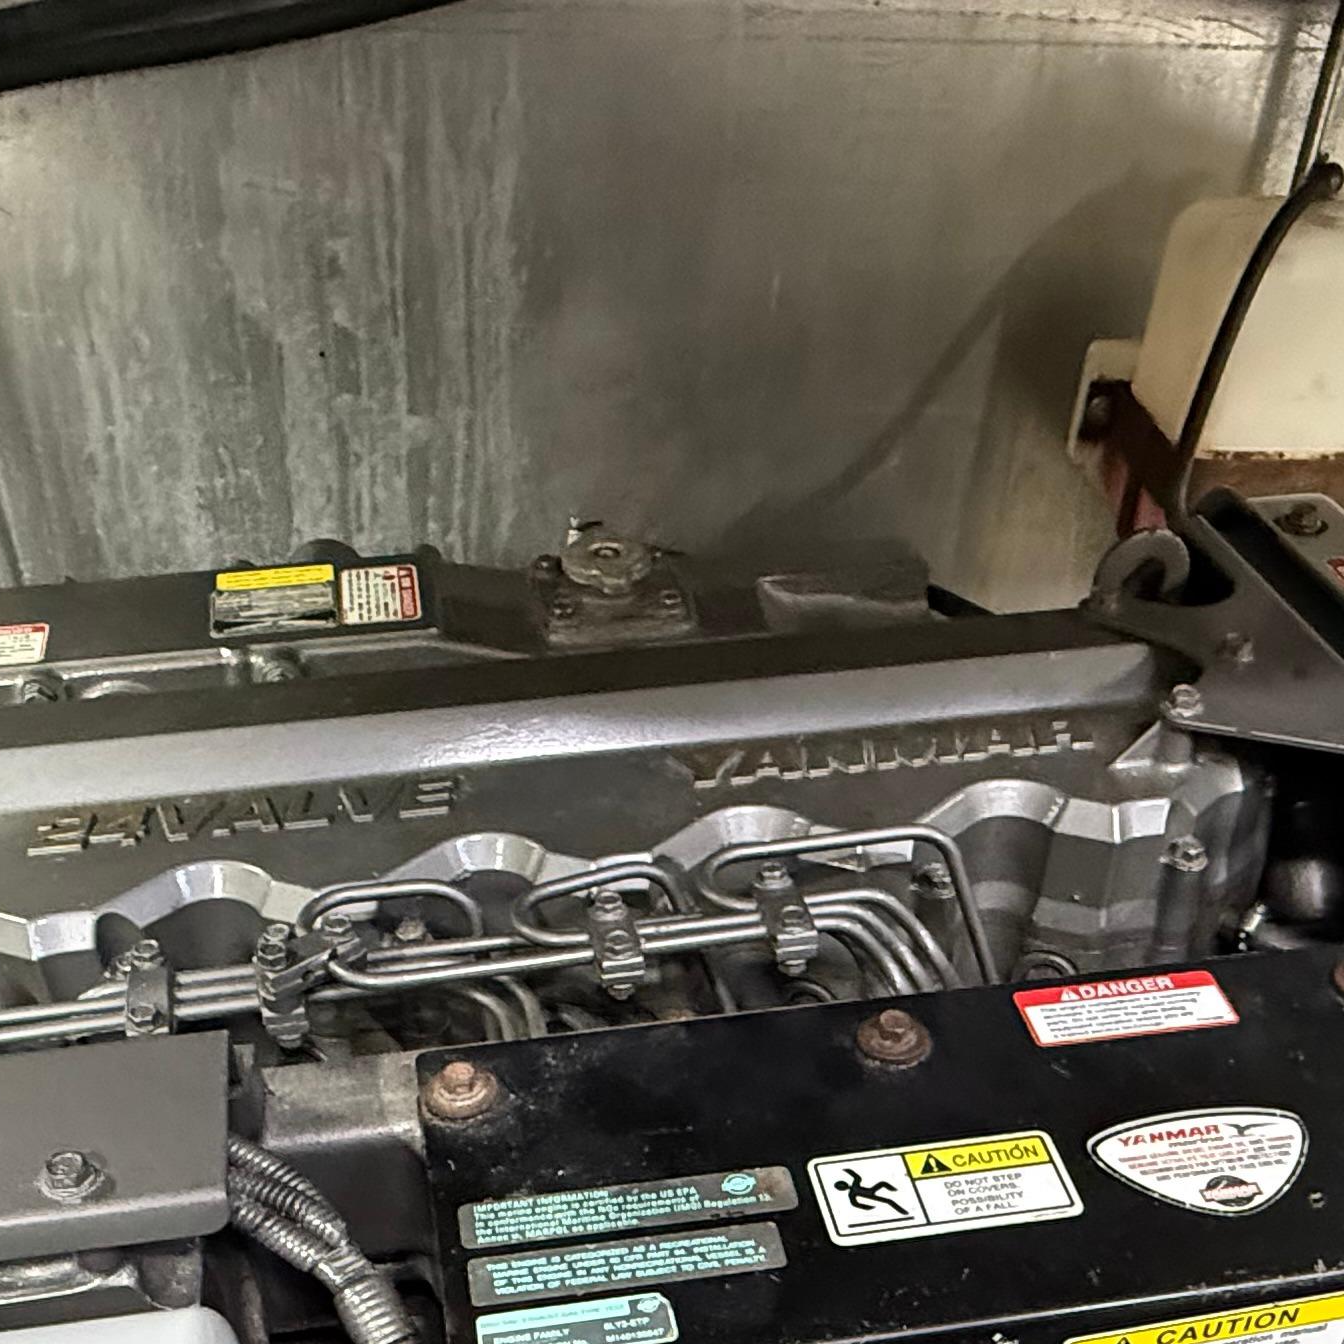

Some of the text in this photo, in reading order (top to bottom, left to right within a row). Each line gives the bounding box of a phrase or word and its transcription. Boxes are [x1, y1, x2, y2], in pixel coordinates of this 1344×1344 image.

[1078, 976, 1174, 999] DANGER
[1118, 1124, 1221, 1147] YANMAR
[952, 1144, 1039, 1167] CAUTION
[944, 1172, 1022, 1189] DO NOT STEP
[947, 1189, 965, 1197] ON
[951, 1191, 1024, 1206] POSSIBILITY
[473, 1198, 533, 1213] IMPORTANT
[954, 1207, 970, 1215] OF
[493, 1328, 570, 1344] ENGINE FAMILY
[1280, 1323, 1328, 1338] manual
